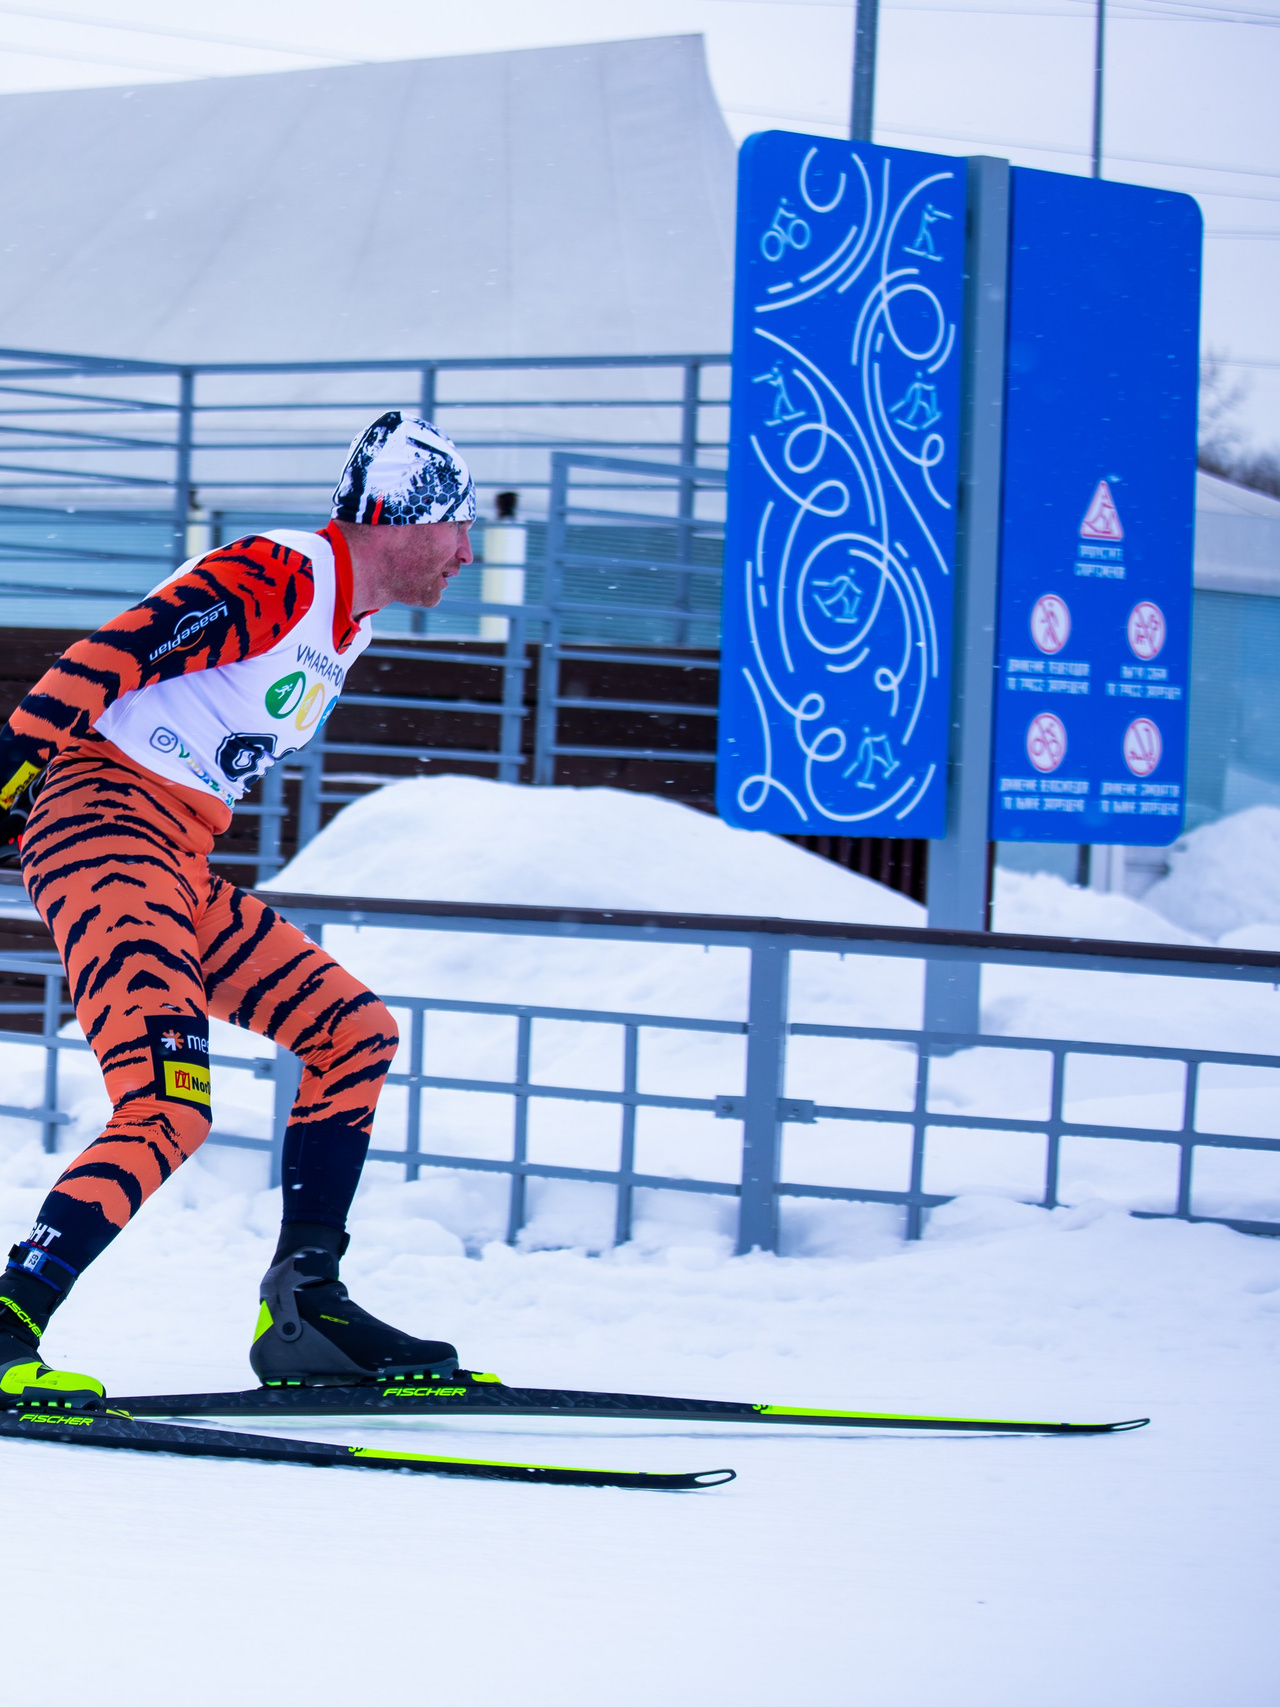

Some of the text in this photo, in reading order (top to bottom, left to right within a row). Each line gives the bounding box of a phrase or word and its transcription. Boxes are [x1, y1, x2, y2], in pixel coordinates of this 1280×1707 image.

[149, 604, 229, 661] LeasePlan
[383, 1387, 468, 1398] FISCHER
[19, 1413, 95, 1427] FISCHER
